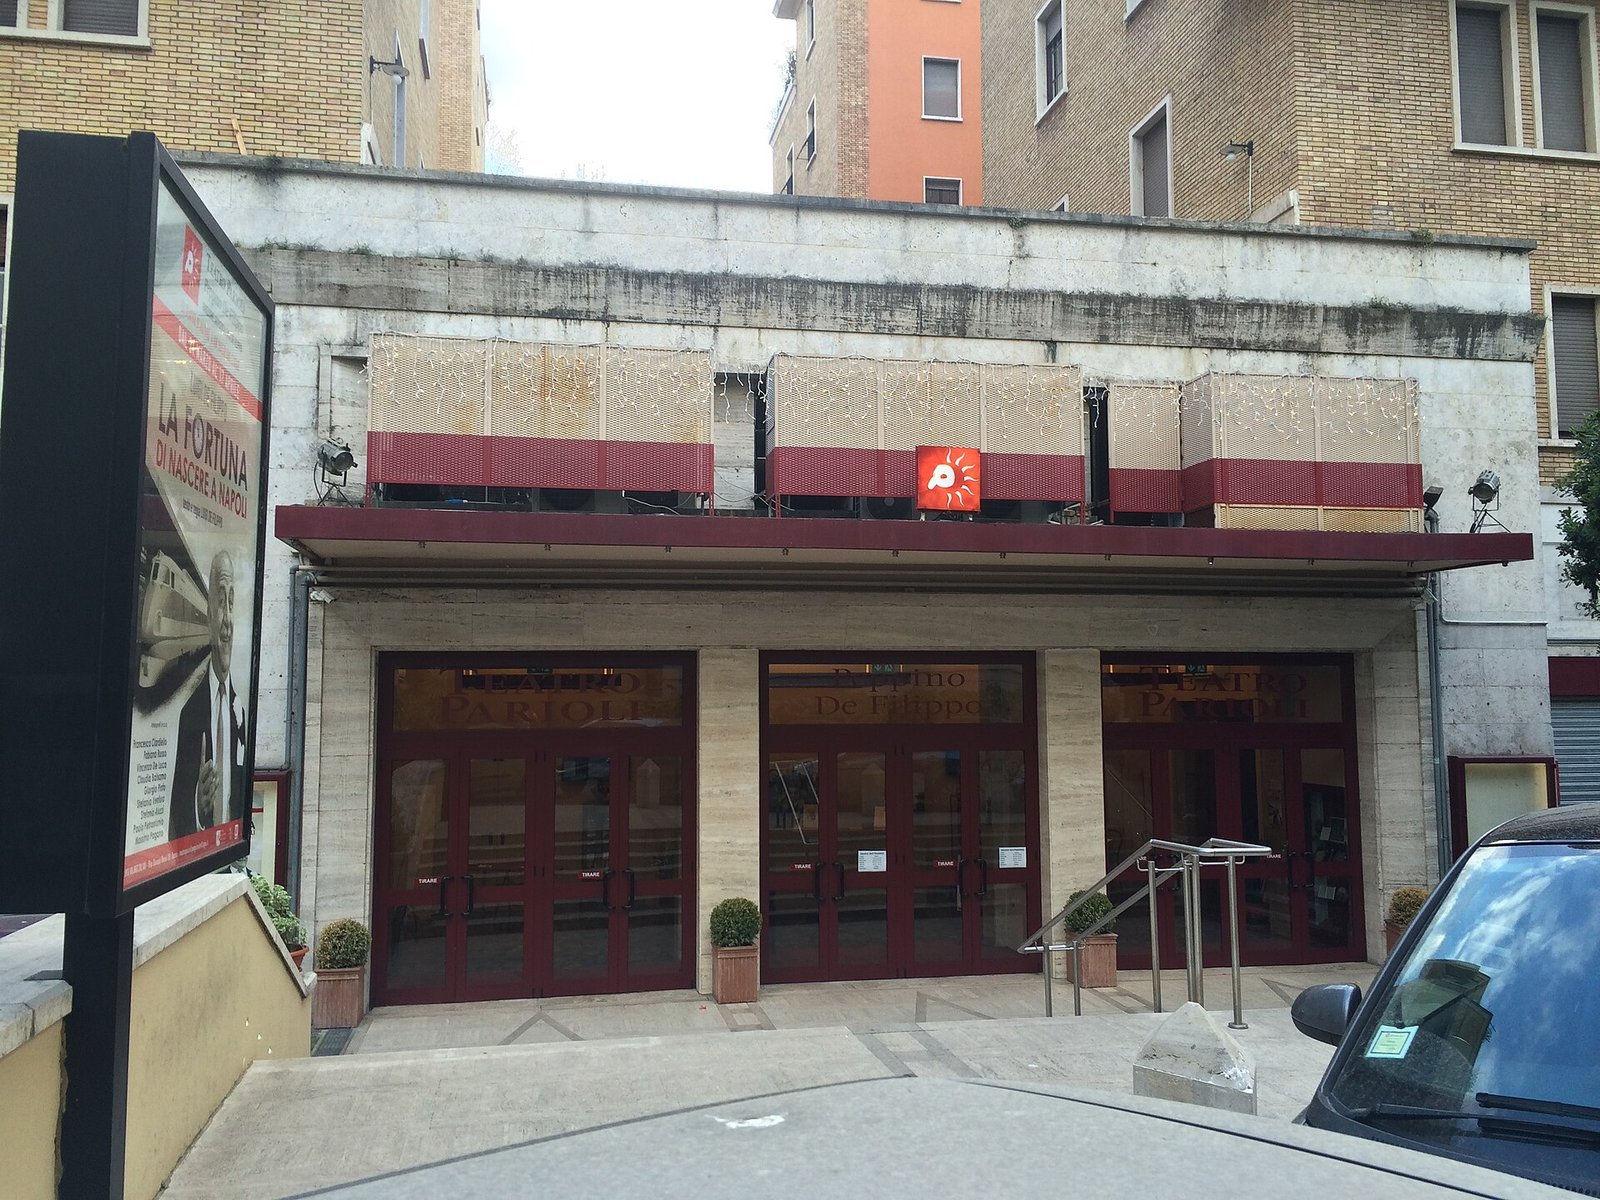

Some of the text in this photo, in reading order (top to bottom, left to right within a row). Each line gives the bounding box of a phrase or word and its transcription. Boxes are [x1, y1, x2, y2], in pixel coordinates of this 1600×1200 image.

[158, 382, 248, 491] LA FORTUNA
[156, 438, 248, 519] DI NASCERE A NAPOLI
[440, 666, 643, 694] TEATRO
[1139, 665, 1308, 694] TEATRO
[440, 696, 643, 724] PARIOLI
[815, 694, 985, 720] De Filippo
